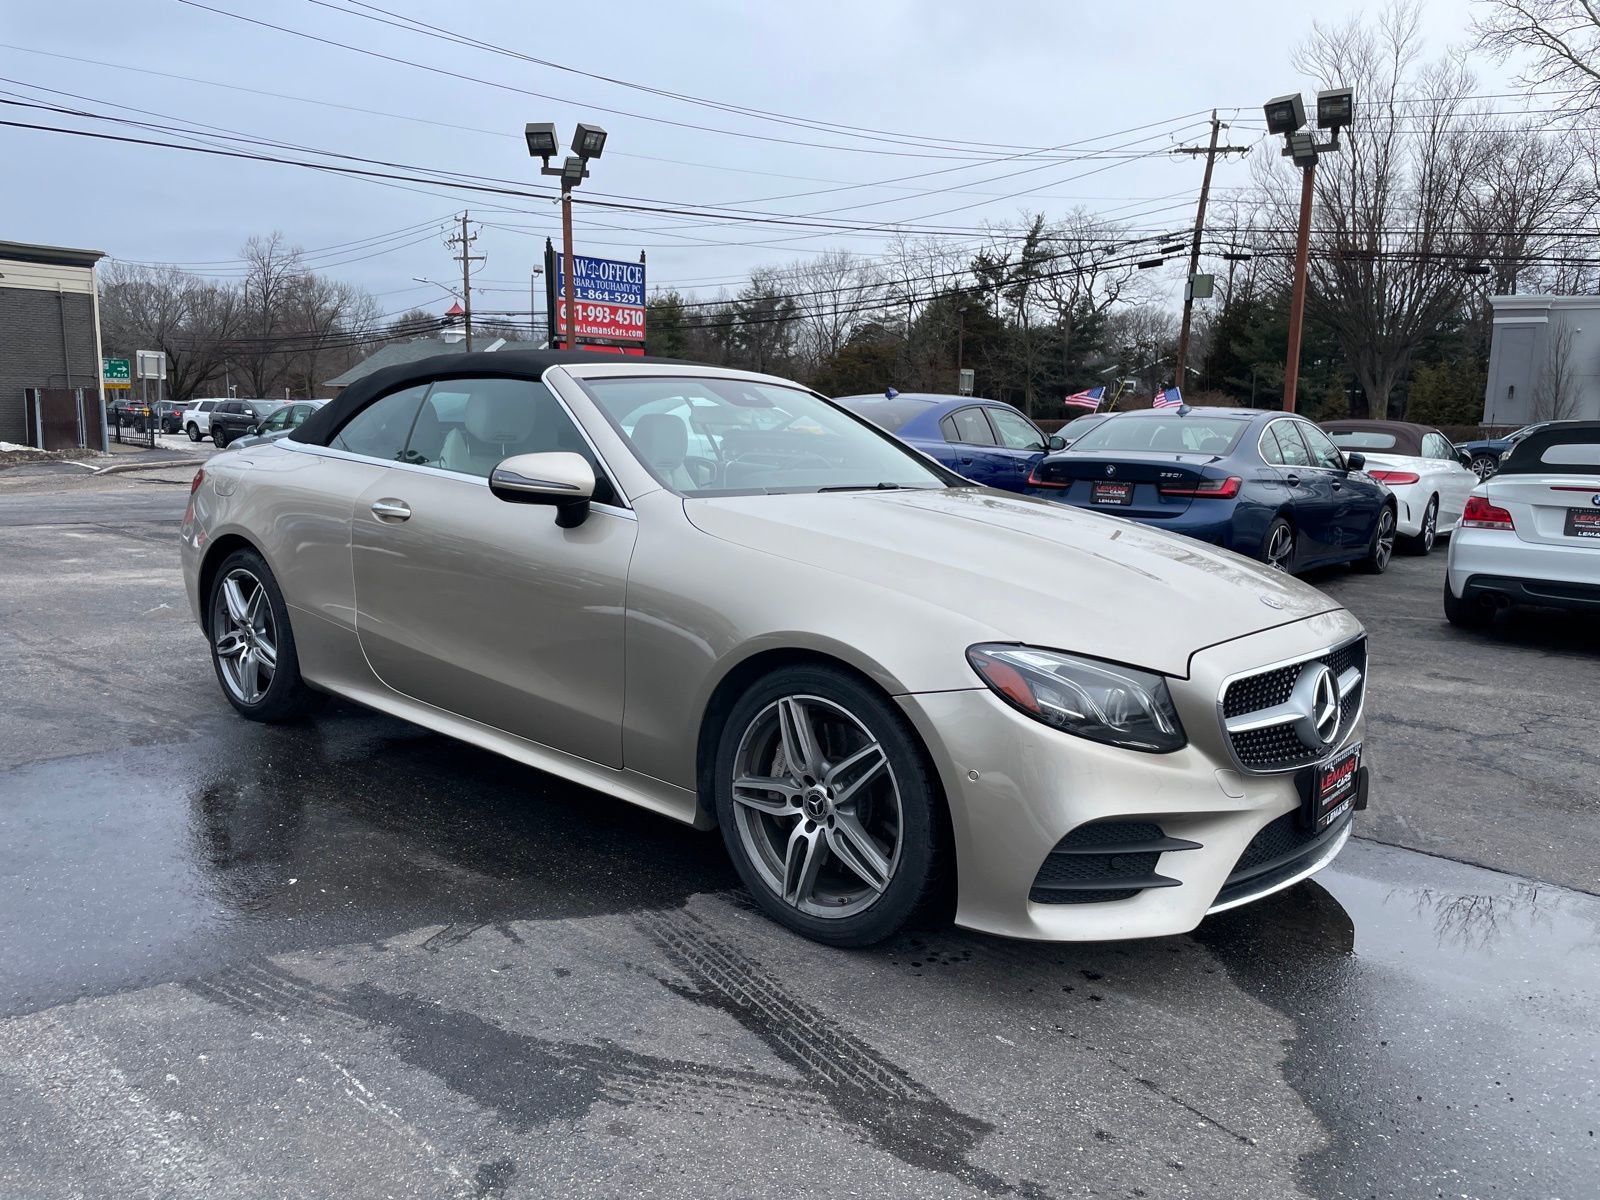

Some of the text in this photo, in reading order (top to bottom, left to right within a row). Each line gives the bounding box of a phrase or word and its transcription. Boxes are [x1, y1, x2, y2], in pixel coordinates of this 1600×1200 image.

[560, 256, 643, 284] LW OFFICE
[560, 286, 642, 304] 61-864-5291
[562, 276, 641, 294] RBARA TOUHAMY PC
[560, 304, 643, 326] 61-993-4510
[560, 323, 643, 338] ww.LemansCars.com
[1321, 756, 1355, 790] LEMANS
[1327, 800, 1349, 825] LEMANS
